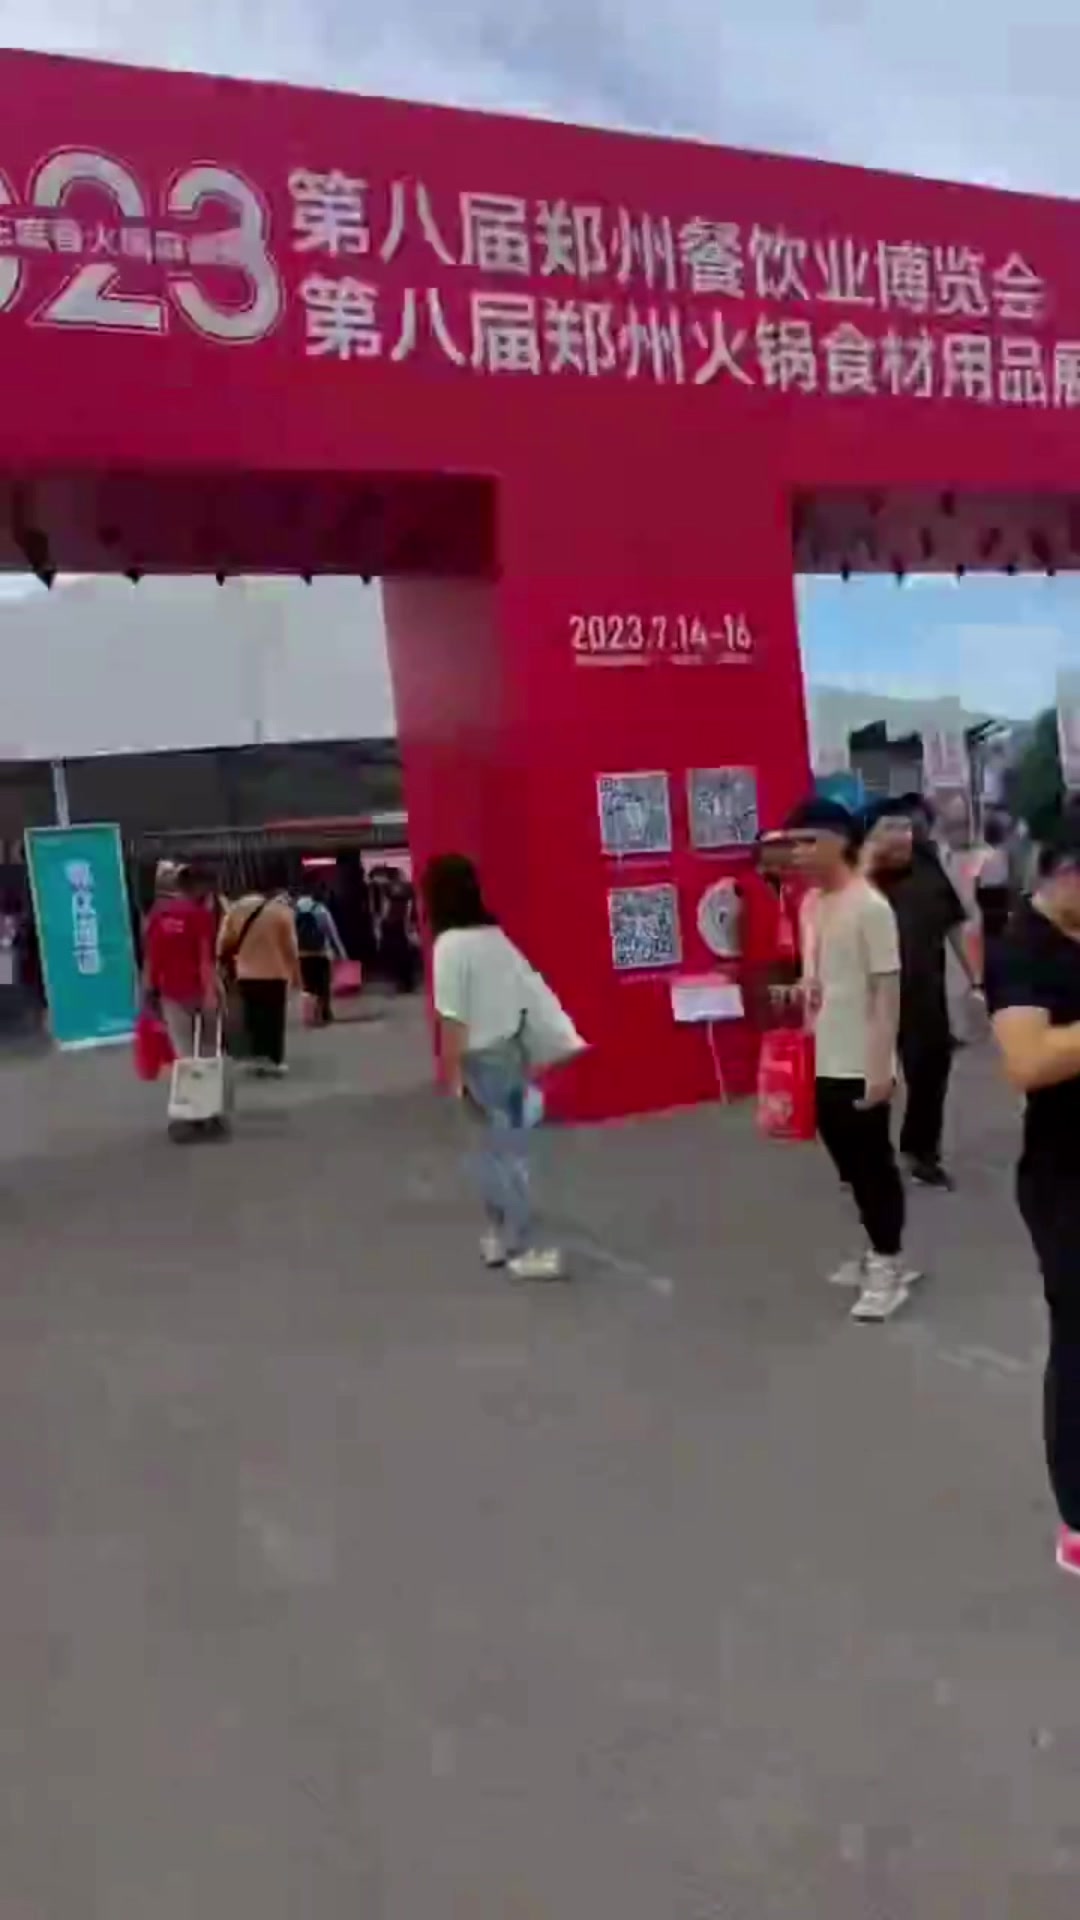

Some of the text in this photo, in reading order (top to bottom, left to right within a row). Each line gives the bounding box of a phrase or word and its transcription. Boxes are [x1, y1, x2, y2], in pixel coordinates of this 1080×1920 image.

[0, 144, 286, 344] 23
[287, 167, 1045, 320] 第八届郑州餐饮业博览会
[569, 612, 752, 651] 2023.7.14-16
